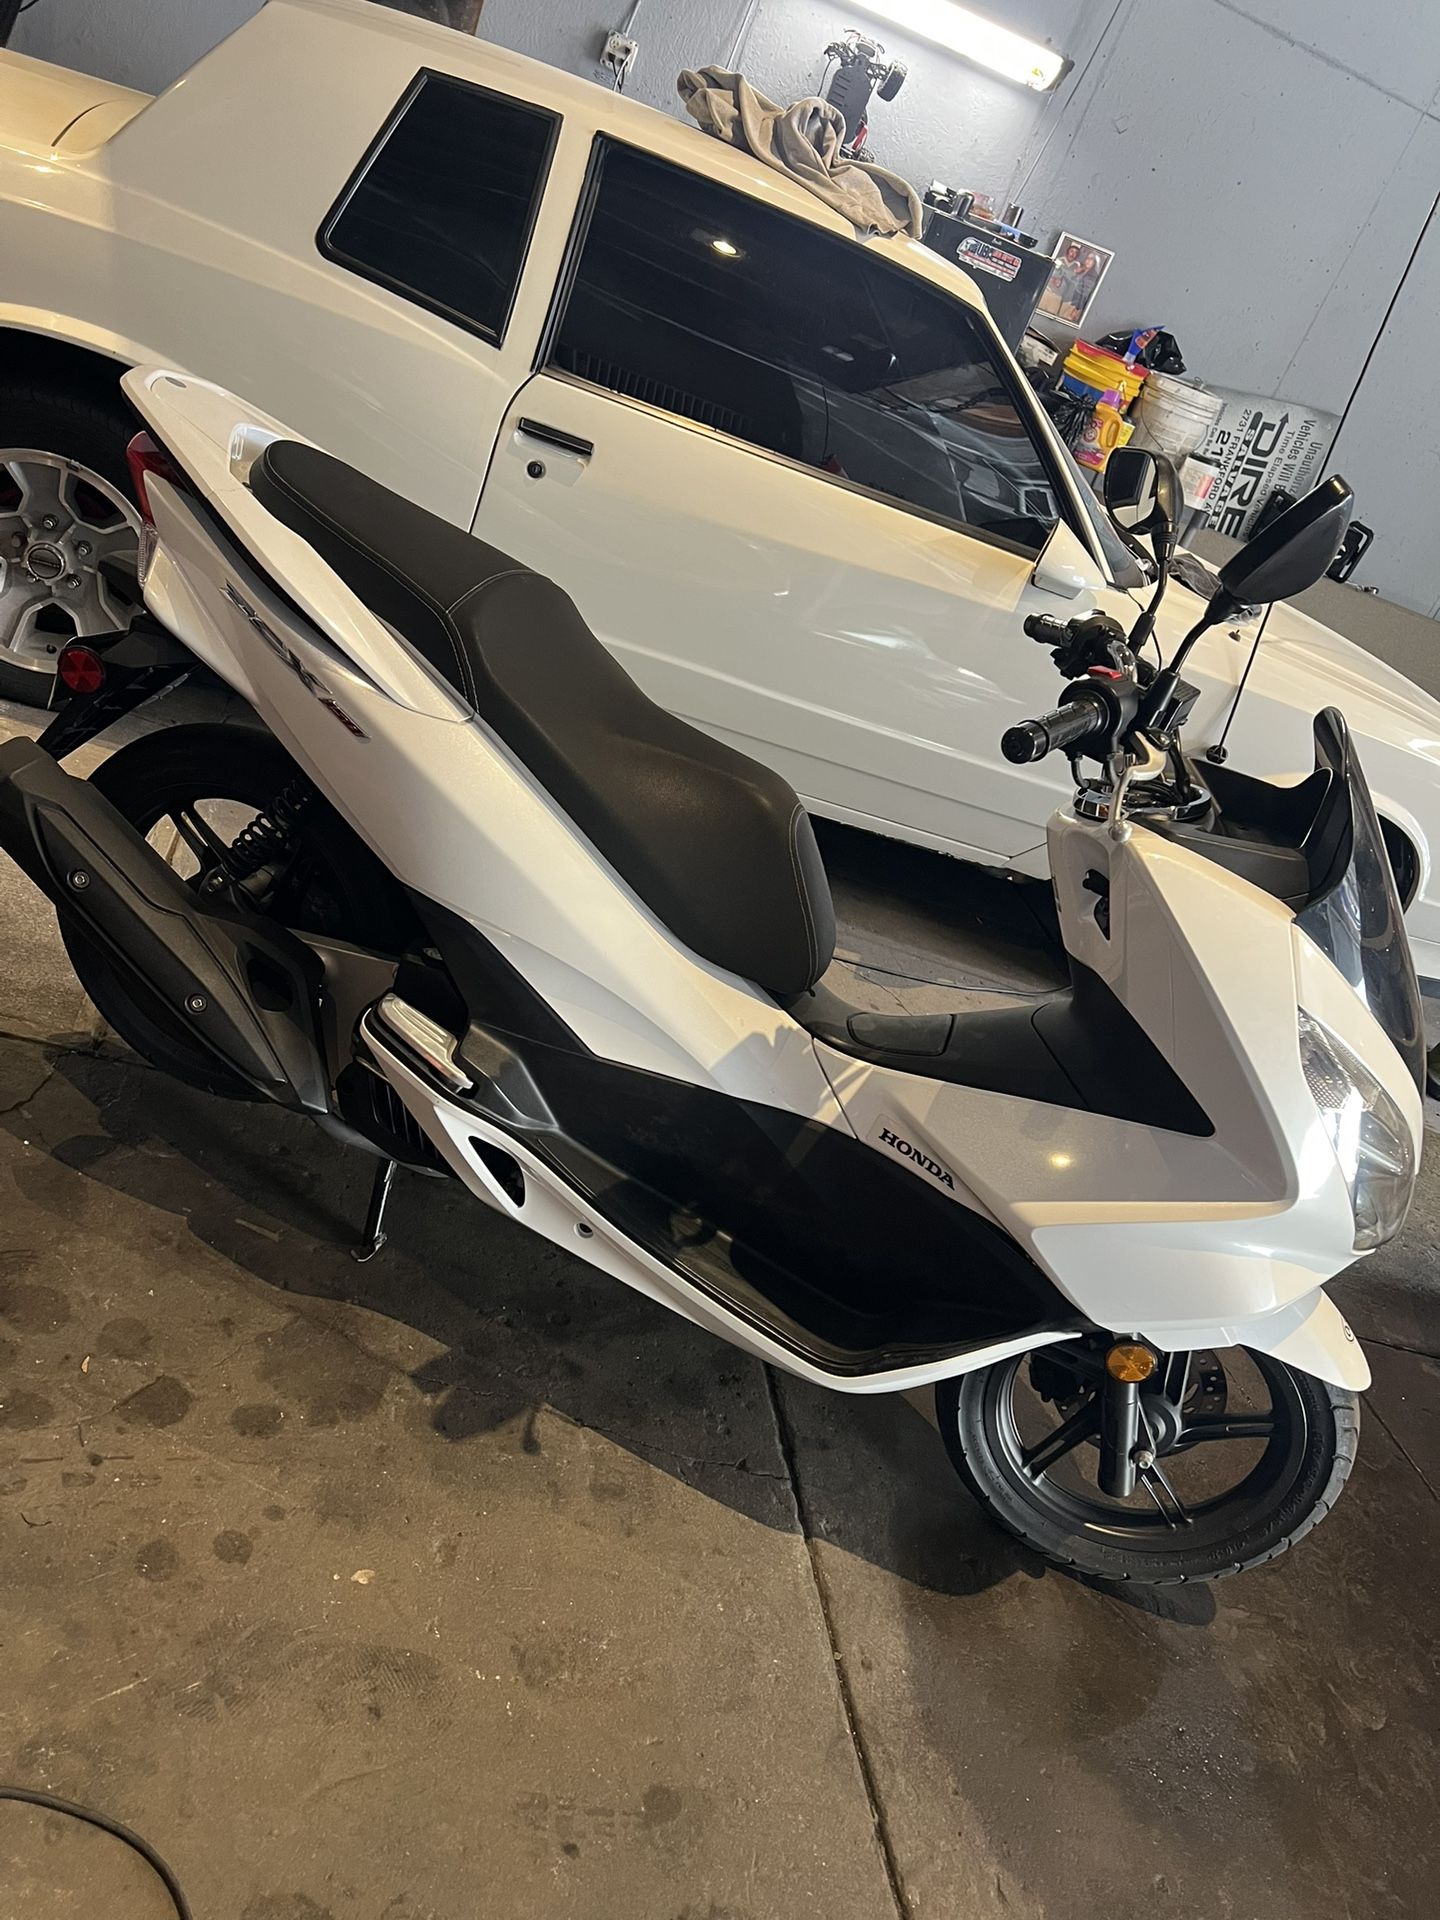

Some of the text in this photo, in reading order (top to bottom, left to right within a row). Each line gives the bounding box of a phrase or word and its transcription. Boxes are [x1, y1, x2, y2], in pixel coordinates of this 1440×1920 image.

[1237, 408, 1252, 433] 2731
[1287, 420, 1317, 460] Vehicles
[1211, 430, 1231, 457] 21
[1279, 431, 1295, 453] Time
[1207, 428, 1255, 528] SALVAGE
[1208, 435, 1241, 500] FRANKFORD
[1217, 414, 1288, 538] DIRE
[1261, 457, 1282, 495] Elapsed
[1278, 463, 1297, 482] Will
[1289, 441, 1323, 494] Unauthoriz
[878, 1127, 955, 1191] HONDA
